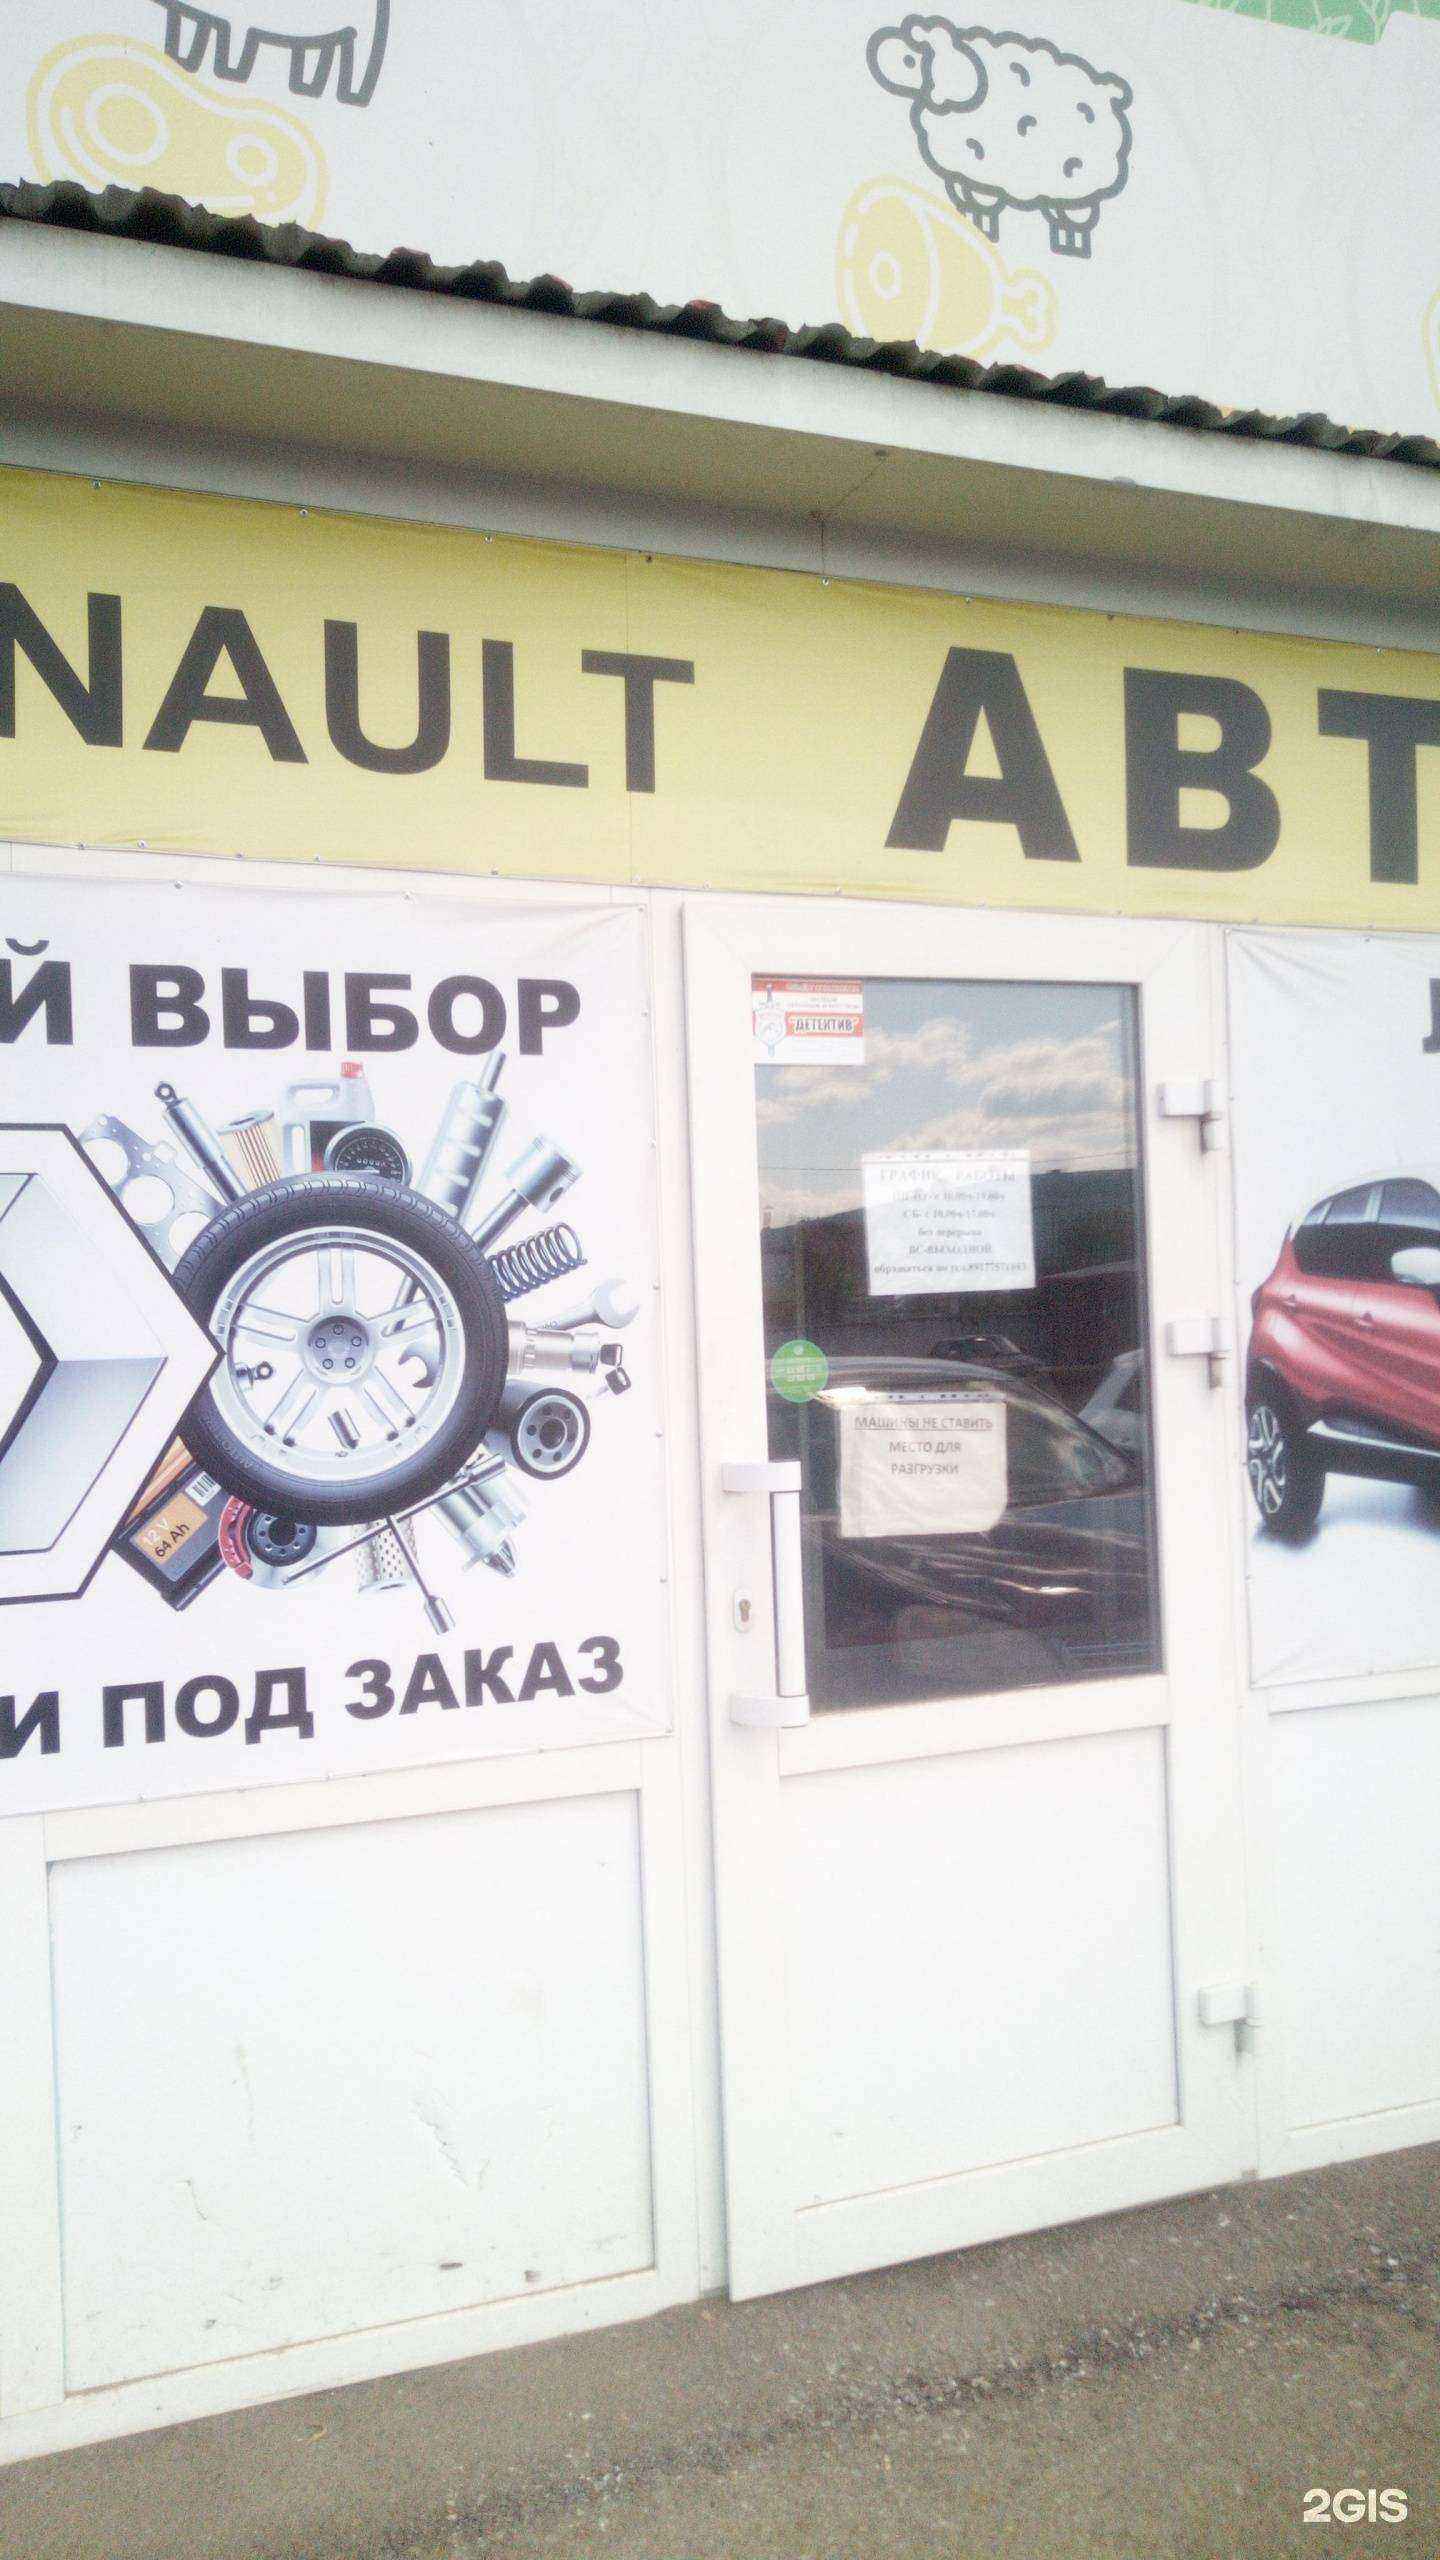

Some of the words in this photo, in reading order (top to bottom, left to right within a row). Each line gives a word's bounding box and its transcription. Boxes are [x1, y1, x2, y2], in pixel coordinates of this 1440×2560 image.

[0, 582, 694, 794] NAULT
[884, 646, 1440, 885] АВТ
[129, 963, 582, 1056] ВЫБОР
[854, 1415, 921, 1430] МАШИНЫ
[923, 1416, 938, 1430] НЕ
[940, 1416, 994, 1430] СТАВИТЬ
[888, 1441, 933, 1454] МЕСТО
[935, 1442, 962, 1456] ДЛЯ
[890, 1462, 961, 1476] РАЗГРУЗКИ
[154, 1540, 172, 1557] 64
[169, 1524, 190, 1543] Ah
[103, 1666, 314, 1750] ПОД
[344, 1635, 625, 1720] ЗАКАЗ
